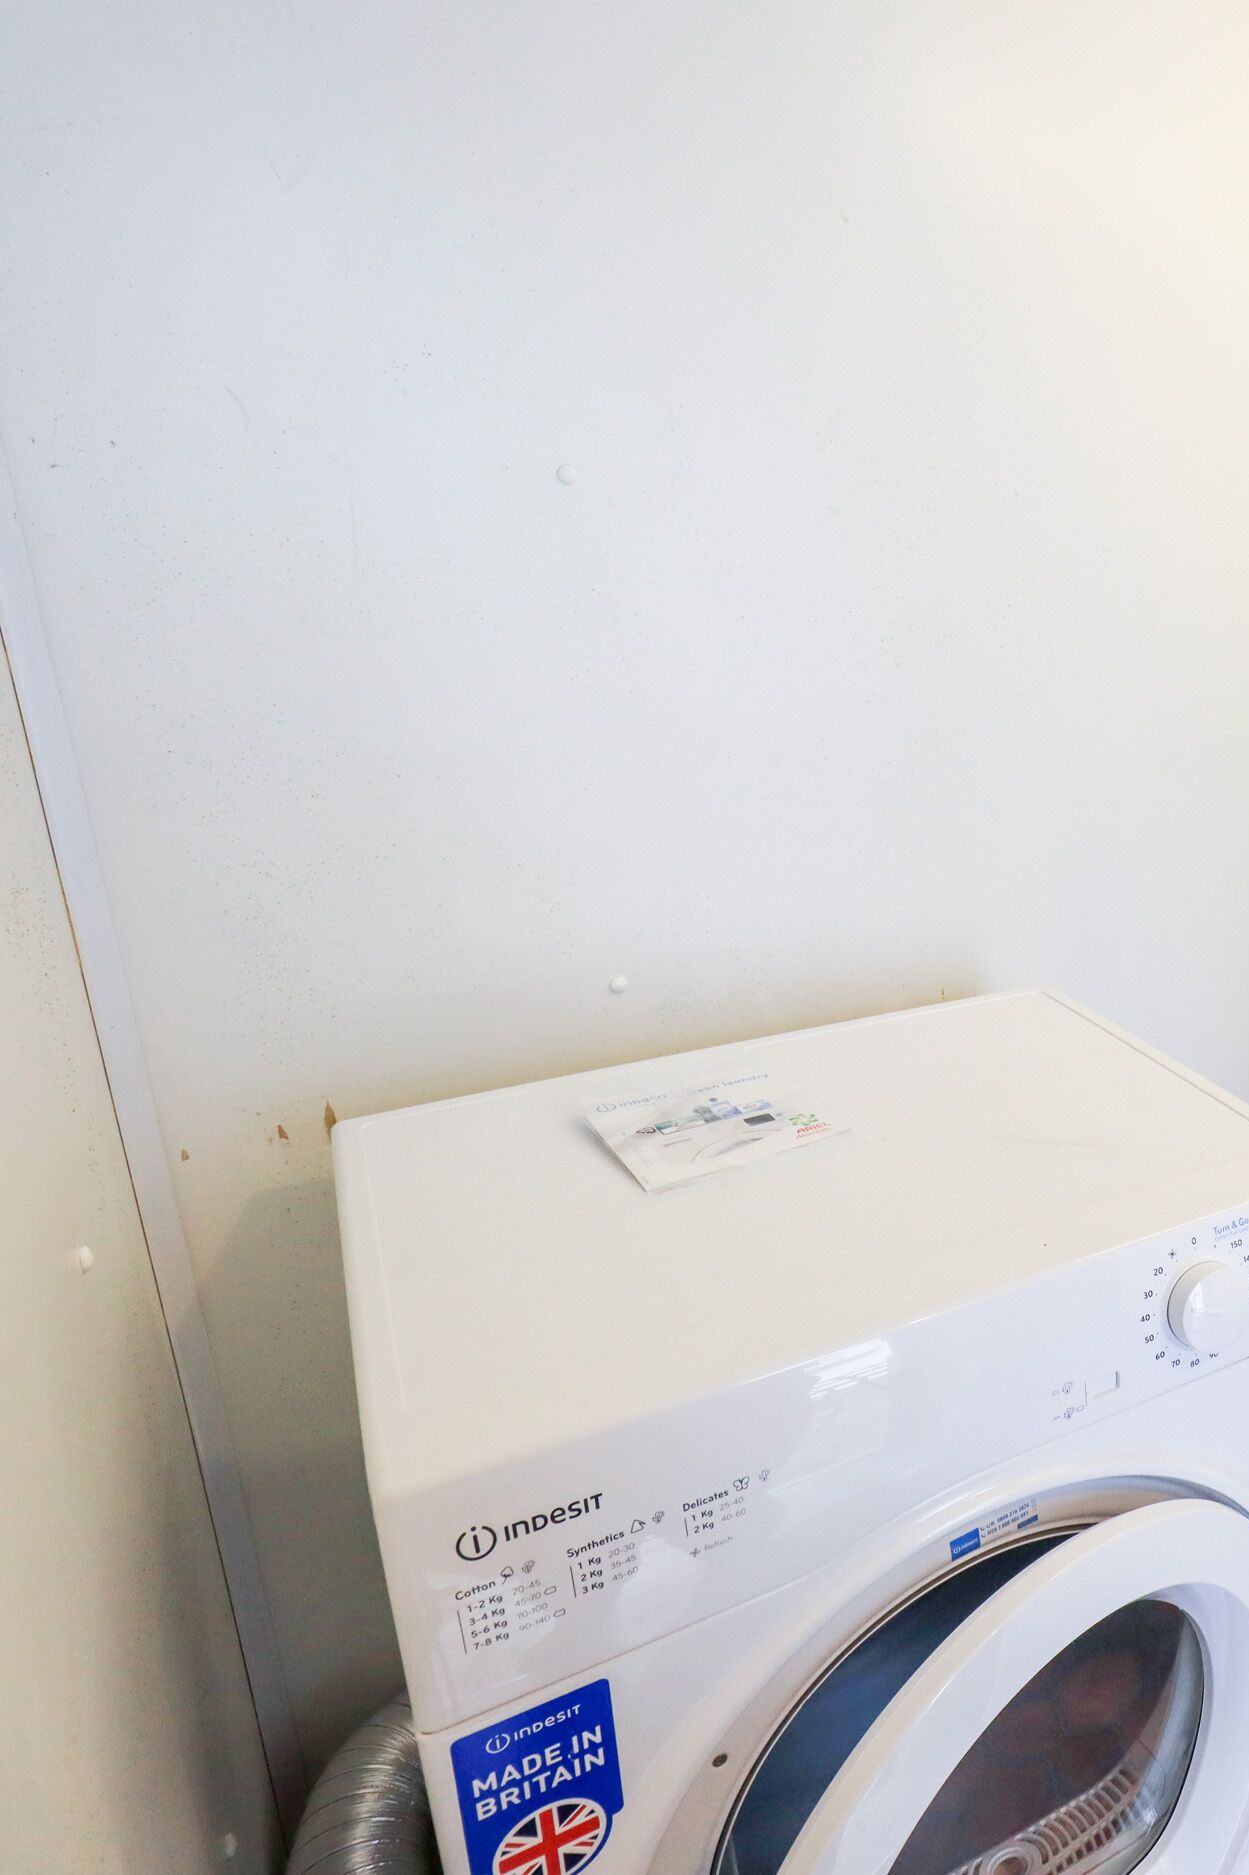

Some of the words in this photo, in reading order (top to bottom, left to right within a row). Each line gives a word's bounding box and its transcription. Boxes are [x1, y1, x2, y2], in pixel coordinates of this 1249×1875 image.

[1213, 1225, 1230, 1235] Turn
[1231, 1220, 1238, 1229] &
[1238, 1217, 1249, 1226] Go
[1191, 1237, 1197, 1246] 0
[1230, 1239, 1243, 1249] 150
[1153, 1267, 1164, 1277] 20
[1143, 1290, 1154, 1300] 30
[1140, 1314, 1151, 1323] 40
[1144, 1334, 1155, 1343] 50
[1155, 1350, 1166, 1361] 60
[1171, 1358, 1181, 1368] 70
[1190, 1358, 1200, 1368] 80
[683, 1489, 729, 1512] Delicates
[701, 1509, 714, 1519] Kg
[720, 1496, 745, 1512] 25-40
[694, 1525, 700, 1534] 2
[702, 1521, 715, 1531] Kg
[721, 1507, 747, 1522] 40-60
[567, 1531, 625, 1557] Synthetics
[588, 1557, 602, 1566] Kg
[608, 1542, 635, 1559] 20-30
[581, 1573, 587, 1582] 2
[590, 1569, 603, 1579] Kg
[611, 1554, 637, 1570] 35-45
[455, 1581, 496, 1601] Cotton
[582, 1586, 589, 1595] 3
[591, 1581, 604, 1591] Kg
[612, 1566, 639, 1581] 45-60
[467, 1600, 485, 1613] 1-2
[489, 1595, 503, 1605] Kg
[511, 1579, 541, 1596] 20-45
[469, 1613, 488, 1626] 3-4
[492, 1607, 506, 1618] Kg
[514, 1592, 542, 1607] 45-70
[471, 1625, 490, 1639] 5-6
[494, 1619, 508, 1630] Kg
[517, 1602, 549, 1620] 70-100
[473, 1638, 492, 1651] 7-8
[495, 1632, 510, 1643] Kg
[471, 1742, 563, 1798] MADE
[571, 1725, 603, 1754] IN
[475, 1747, 606, 1822] BRITAIN
